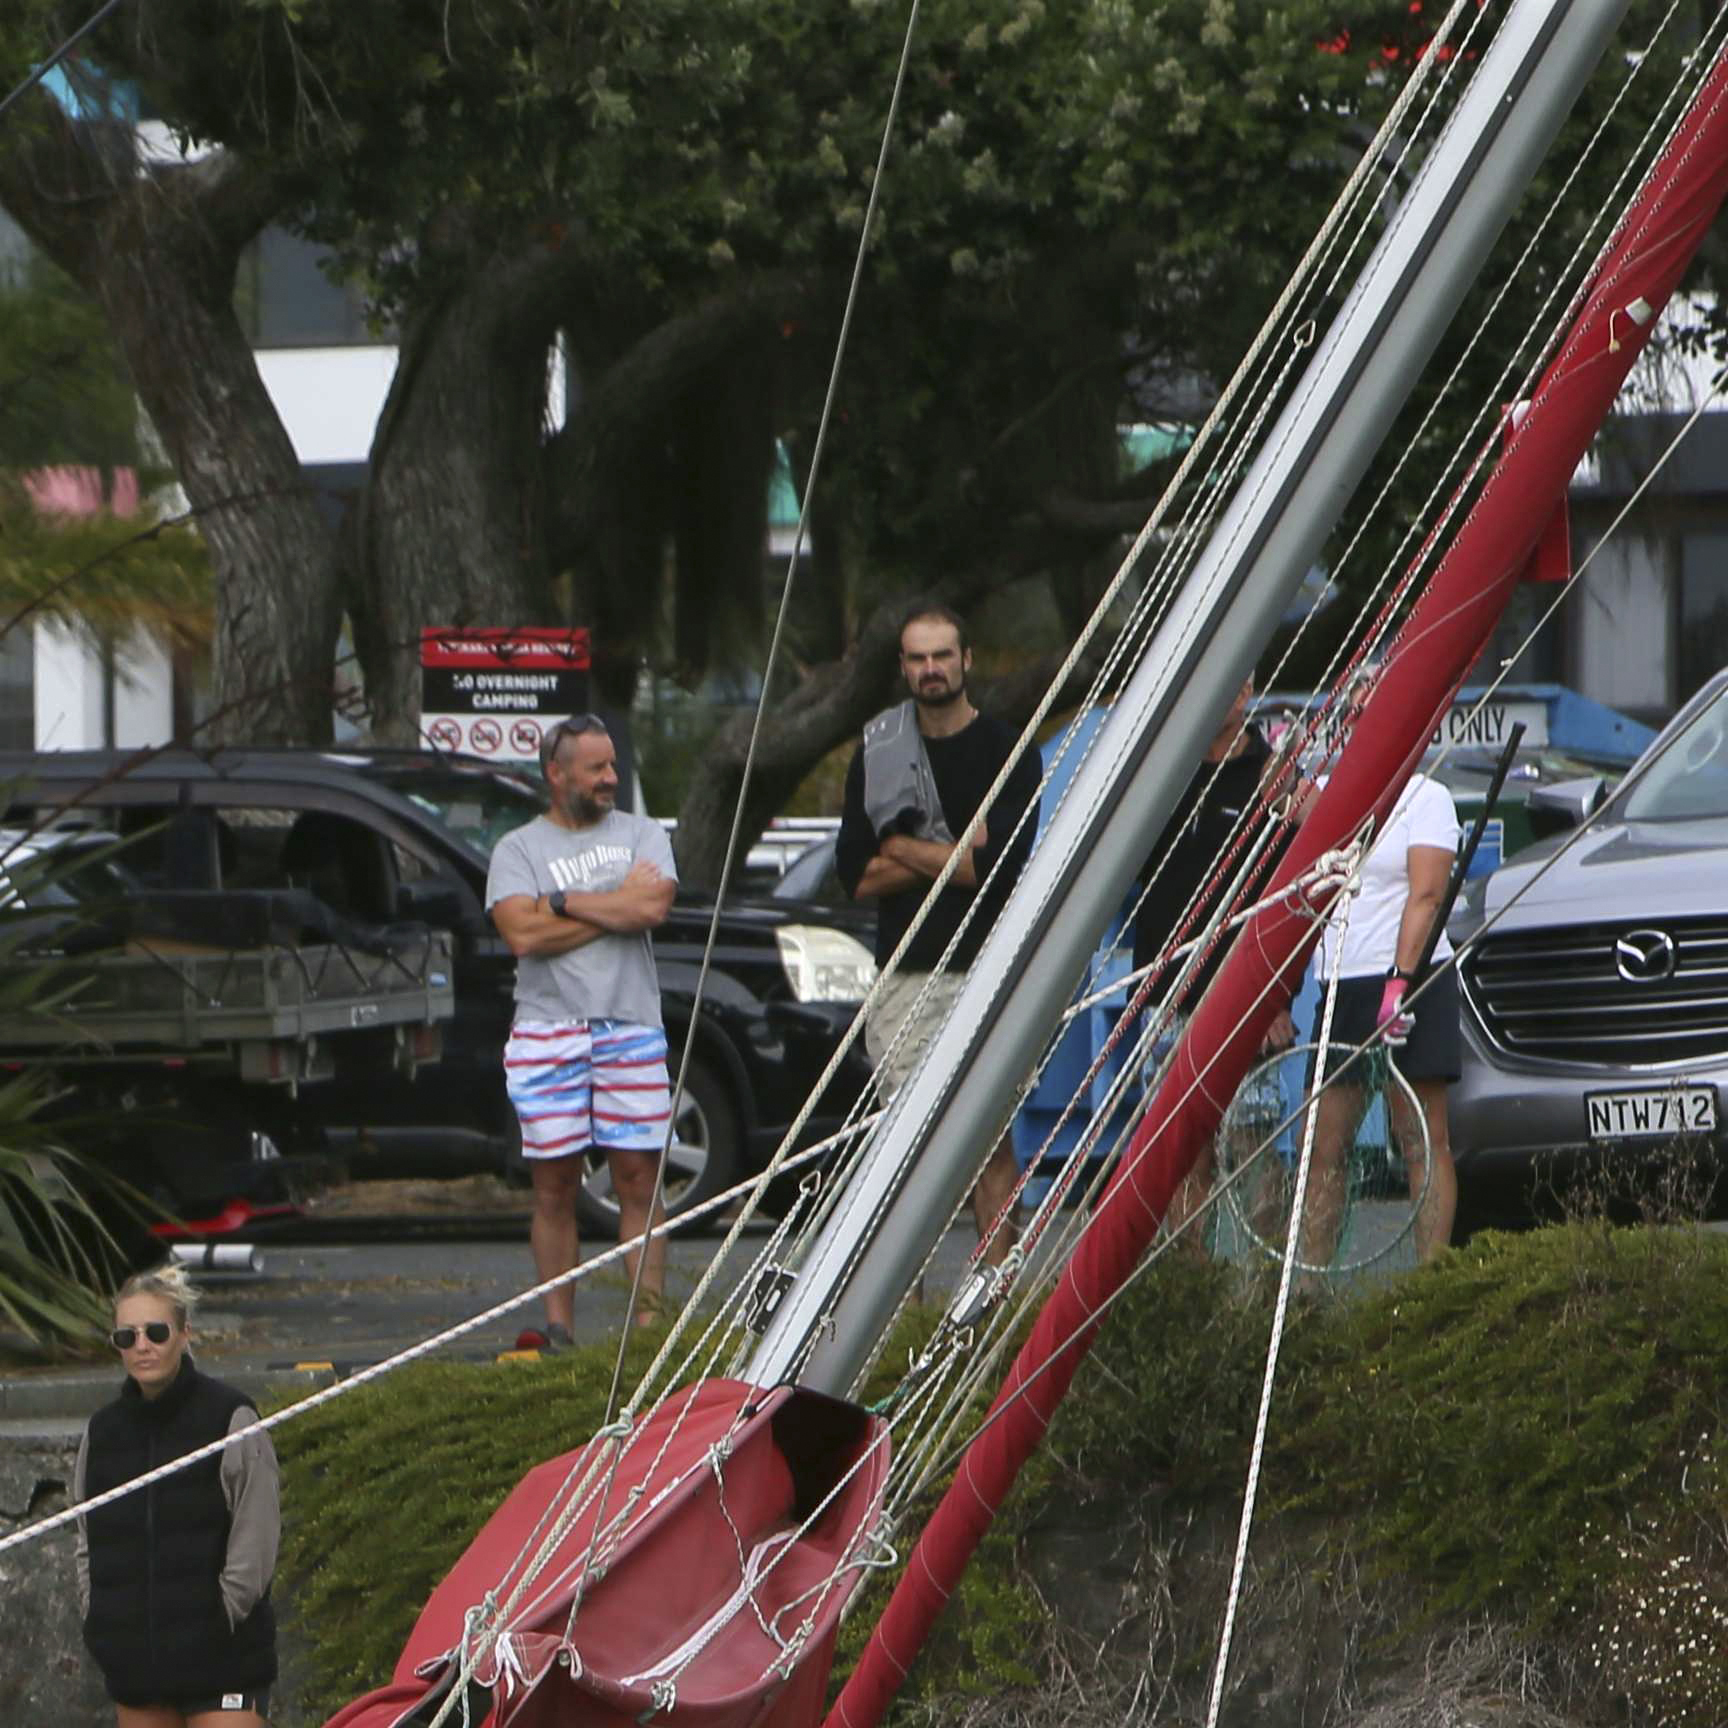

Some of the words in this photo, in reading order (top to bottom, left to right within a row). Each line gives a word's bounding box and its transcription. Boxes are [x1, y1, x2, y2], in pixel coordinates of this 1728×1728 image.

[476, 674, 559, 691] OVERNIGHT
[472, 694, 539, 709] CAMPING
[1449, 705, 1506, 744] ONLY
[1591, 1095, 1712, 1133] NTW712
